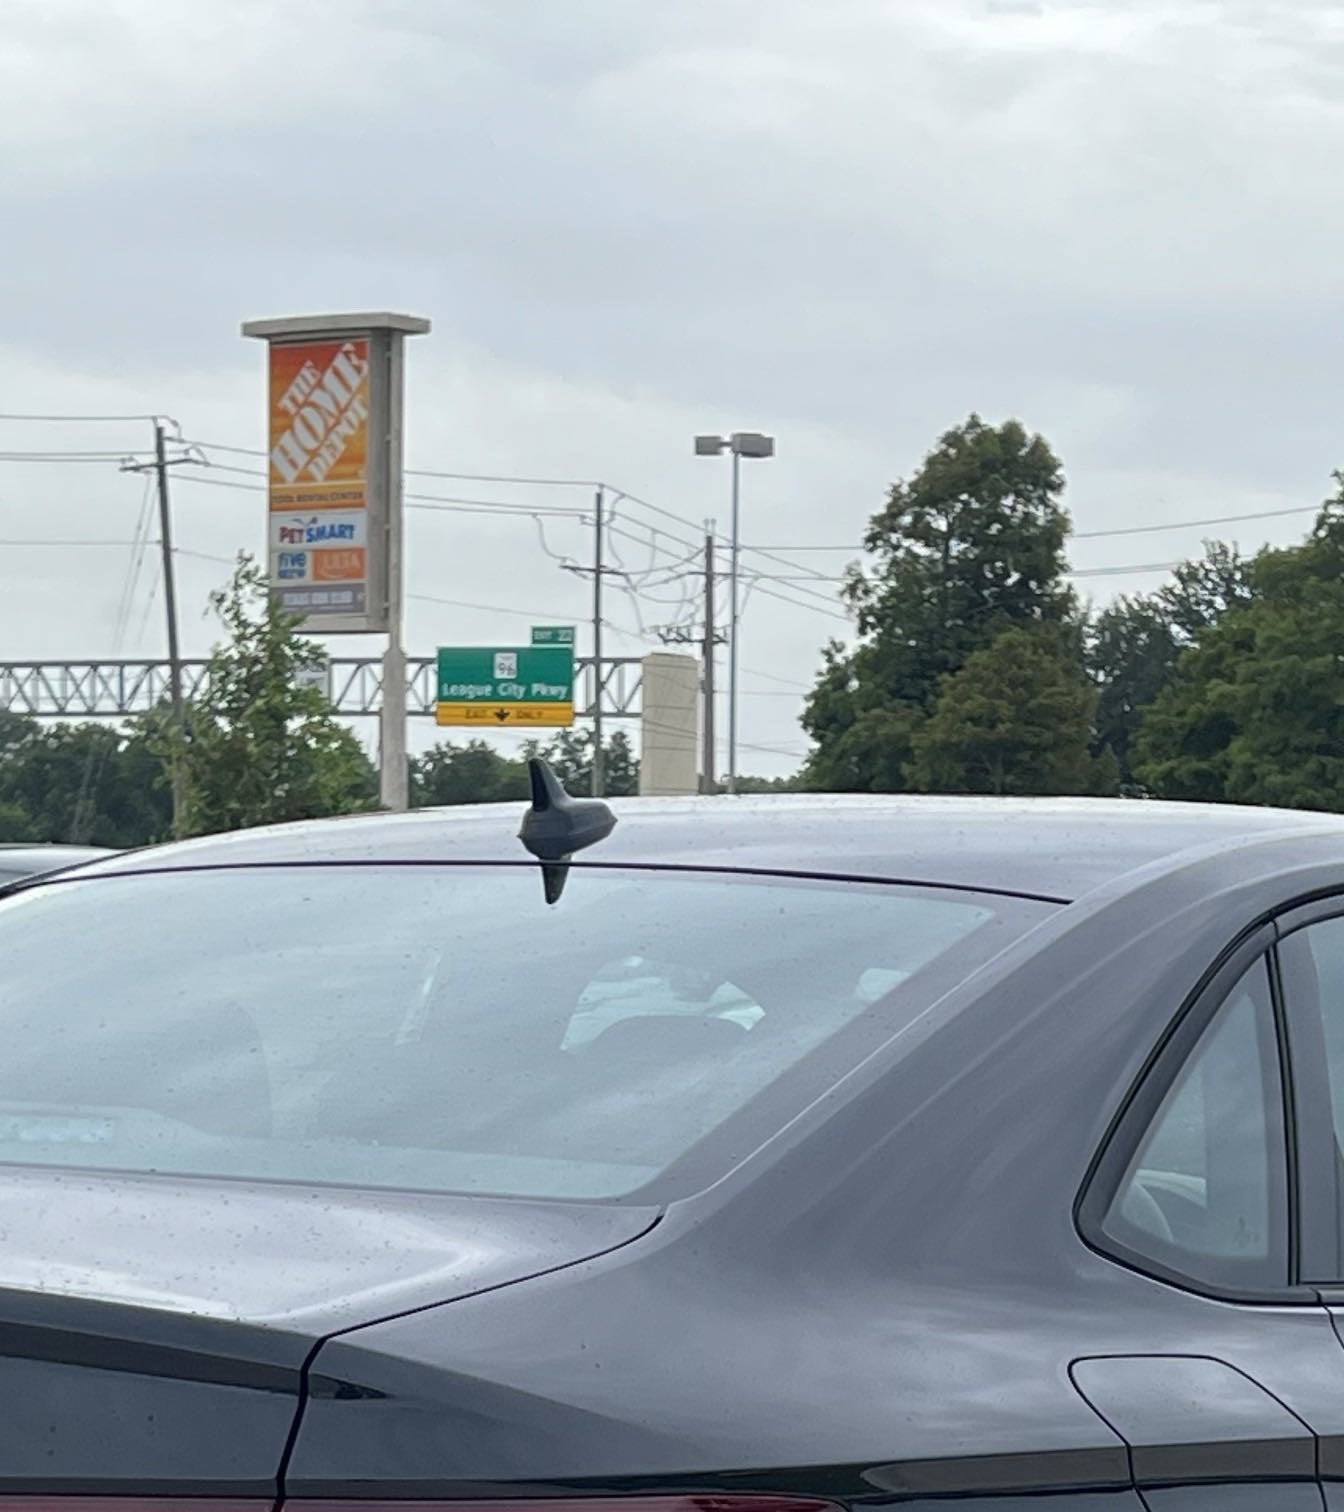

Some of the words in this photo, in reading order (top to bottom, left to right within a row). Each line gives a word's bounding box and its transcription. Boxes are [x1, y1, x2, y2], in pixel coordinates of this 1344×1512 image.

[270, 342, 368, 484] HOME
[277, 360, 321, 416] THE
[306, 394, 368, 482] DEPOT
[442, 682, 493, 699] League
[497, 682, 527, 700] City
[531, 682, 569, 700] Pkwy
